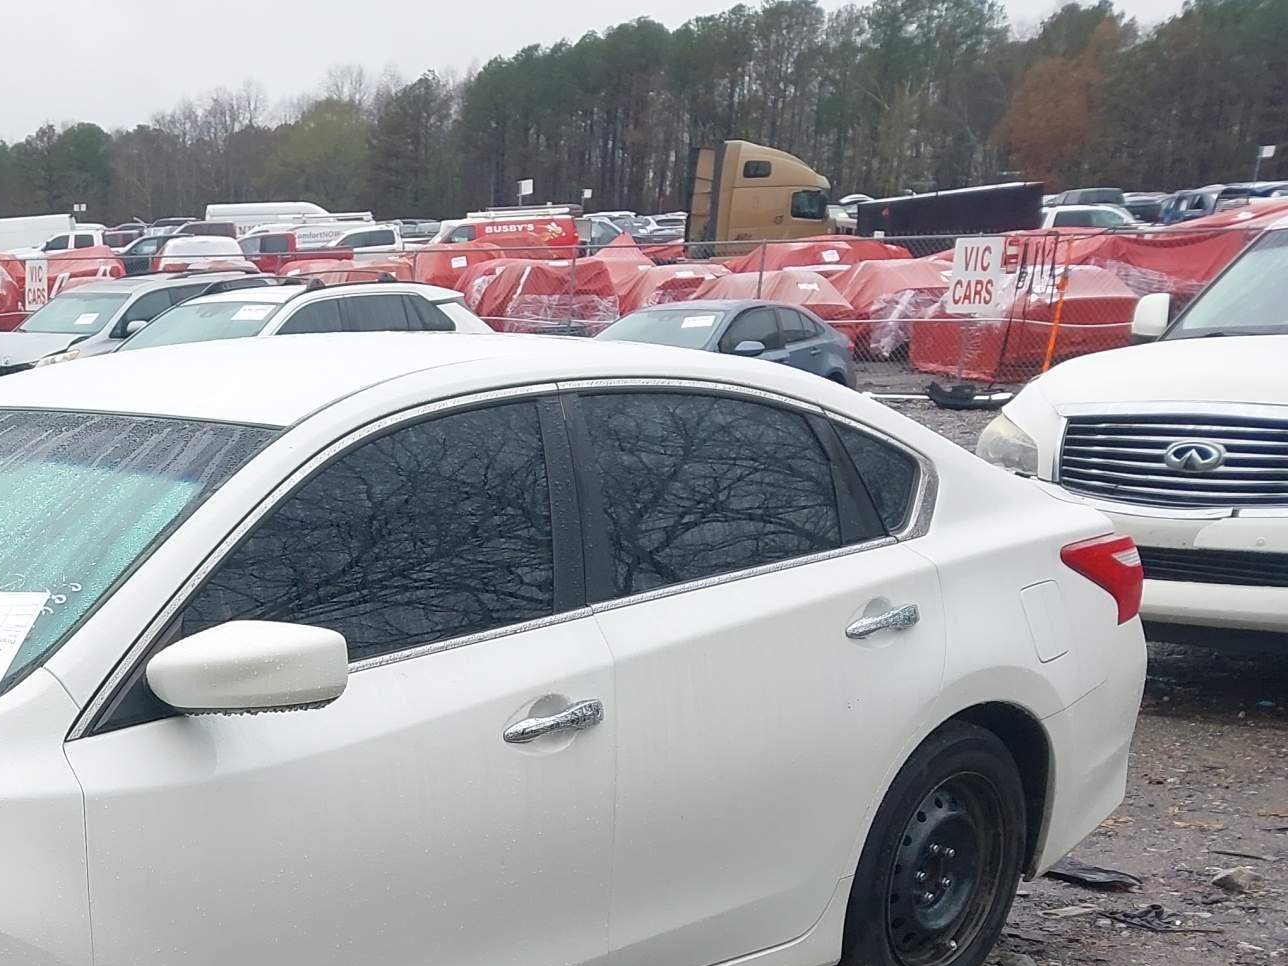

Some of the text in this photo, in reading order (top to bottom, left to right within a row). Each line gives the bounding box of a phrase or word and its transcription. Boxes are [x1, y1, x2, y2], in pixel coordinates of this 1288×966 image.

[485, 224, 534, 234] BUSBY'S
[964, 245, 992, 272] VIC
[29, 265, 43, 283] VIC
[26, 287, 46, 305] CARS
[952, 279, 994, 305] CARS
